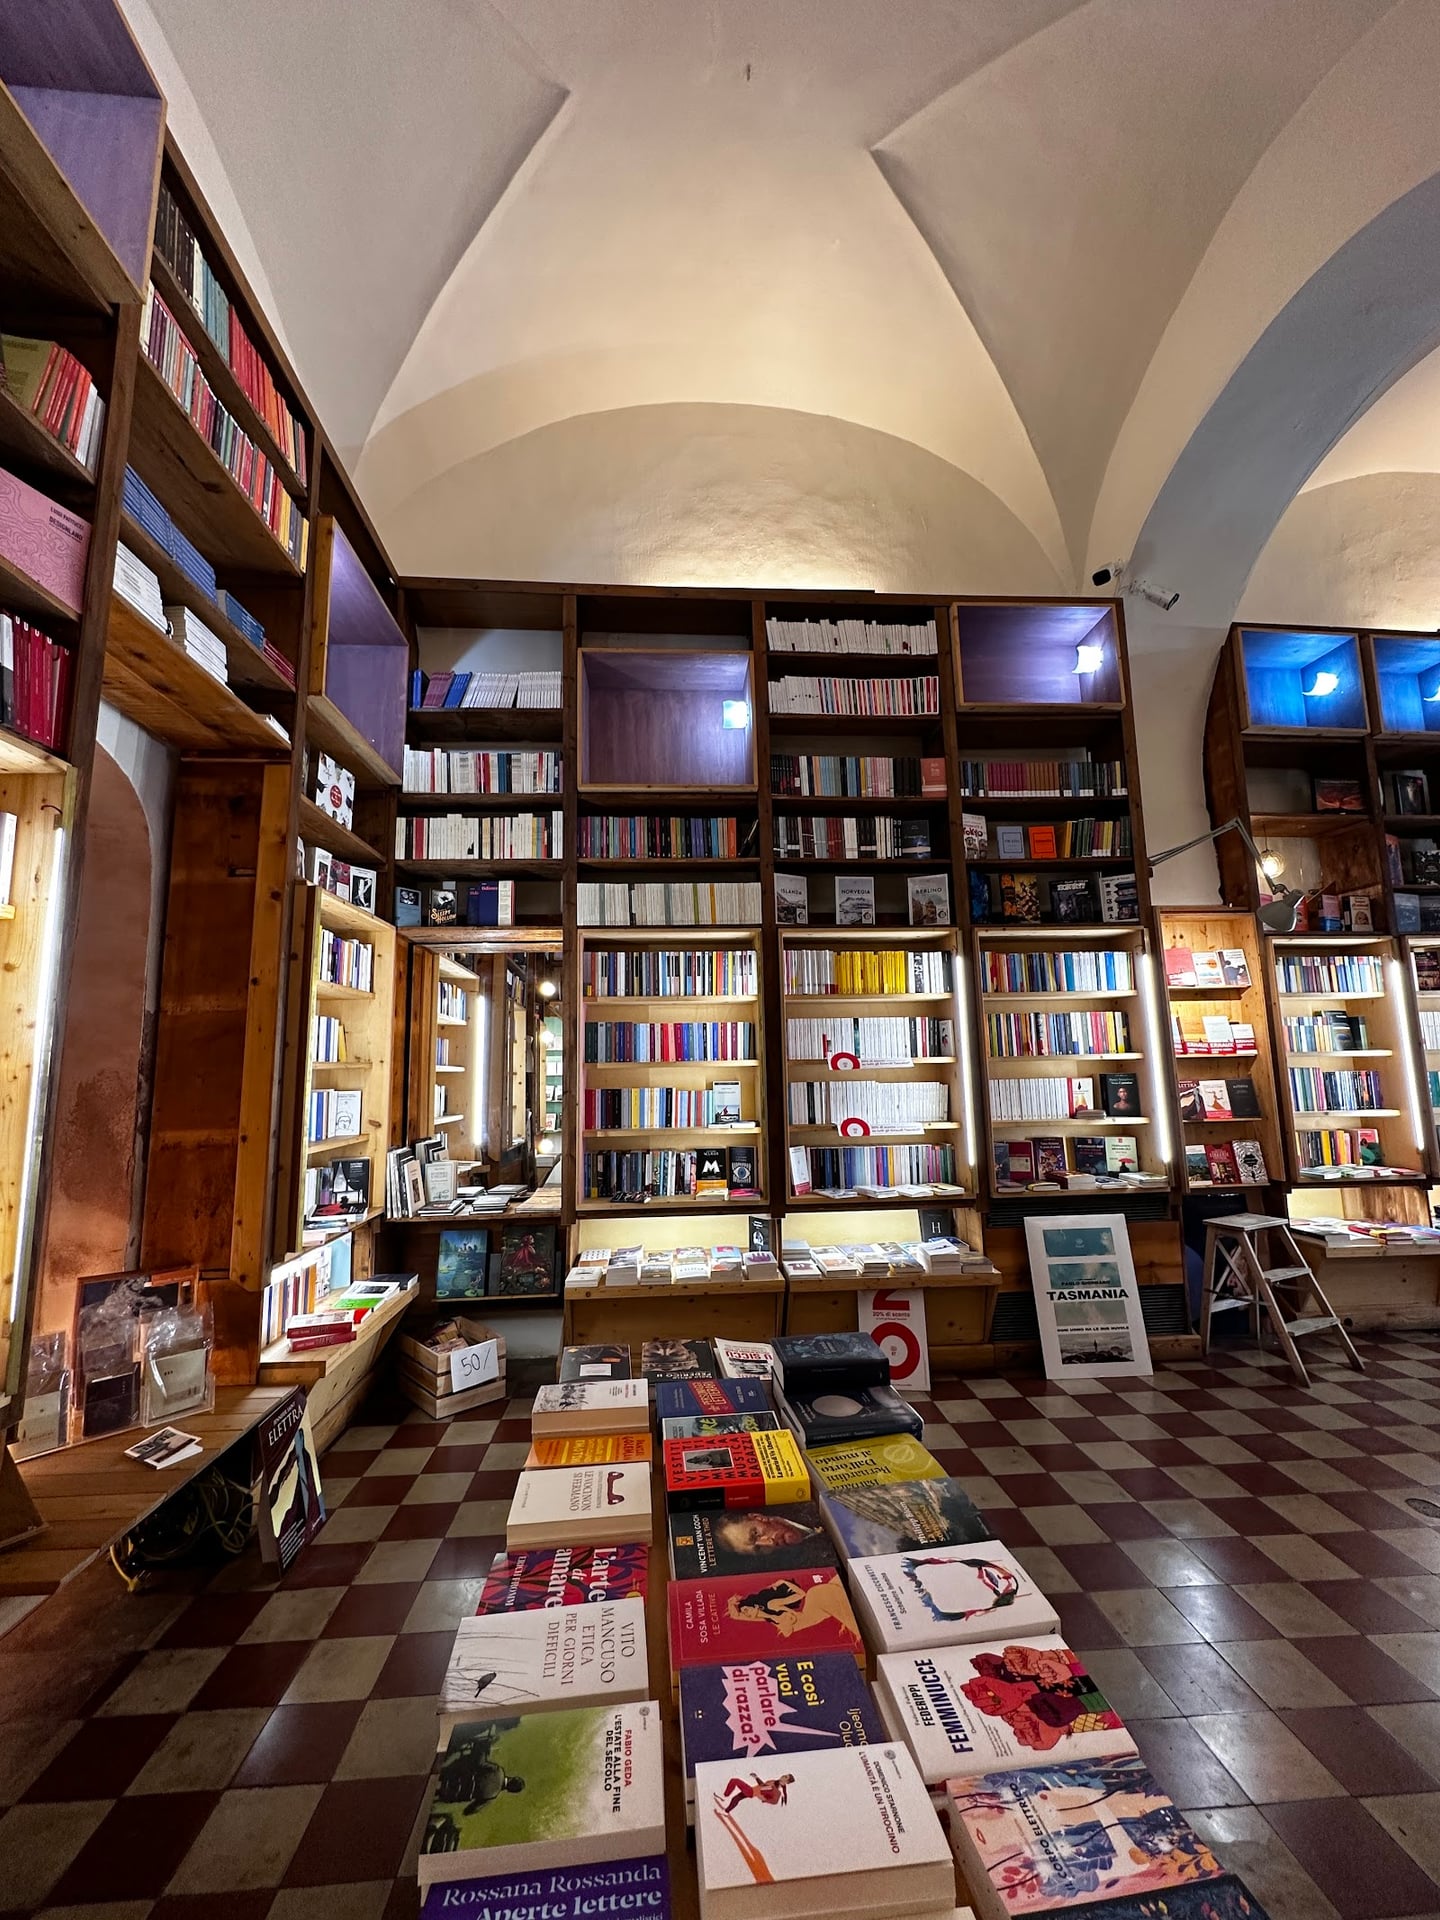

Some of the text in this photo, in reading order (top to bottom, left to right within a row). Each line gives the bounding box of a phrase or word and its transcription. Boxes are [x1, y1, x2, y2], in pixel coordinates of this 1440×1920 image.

[915, 887, 943, 895] BERLINO
[931, 1221, 941, 1234] H
[1046, 1288, 1129, 1301] TASMANIA
[267, 1404, 304, 1447] ELETTRA
[670, 1441, 684, 1484] VESTITI
[734, 1437, 749, 1478] MUSICA
[815, 1451, 860, 1465] mondo
[826, 1465, 891, 1484] Bernardini
[569, 1478, 581, 1512] FERMANO
[581, 1493, 592, 1512] NON
[692, 1514, 707, 1574] VINCENT VAN GOGH
[706, 1538, 717, 1567] LETTERE
[504, 1578, 521, 1607] FROMM
[544, 1547, 573, 1608] amare
[570, 1568, 587, 1582] di
[587, 1547, 617, 1602] L'arte
[685, 1601, 694, 1630] CAMILA
[695, 1590, 709, 1644] SOSA VILLADA
[713, 1624, 721, 1635] LE
[881, 1593, 902, 1630] FRANCESCO
[542, 1620, 560, 1679] DIFFICILI
[560, 1611, 578, 1686] PER GIORNI
[580, 1623, 596, 1667] ETICA
[599, 1606, 616, 1684] MANCUSO
[620, 1621, 636, 1659] VITO
[749, 1665, 777, 1728] parlare
[775, 1663, 799, 1697] vuoi
[797, 1661, 825, 1707] E così
[731, 1668, 761, 1746] di razza?
[907, 1684, 936, 1727] FEDERIPPI
[914, 1657, 975, 1755] FEMMINUCCE
[603, 1730, 614, 1792] DEL SECOLO
[612, 1714, 623, 1813] L'ESTATE ALLA FINE
[623, 1729, 632, 1788] FABIO GEDA
[873, 1760, 891, 1793] DOMENICO
[886, 1793, 905, 1834] STARNONE
[874, 1792, 883, 1806] UN
[1009, 1782, 1044, 1837] ELETTRICO
[877, 1806, 900, 1854] TIROCINIO
[1039, 1838, 1068, 1879] CORPO
[442, 1863, 662, 1907] Rossana Rossanda
[572, 1889, 662, 1916] lettere
[1064, 1880, 1076, 1891] IL
